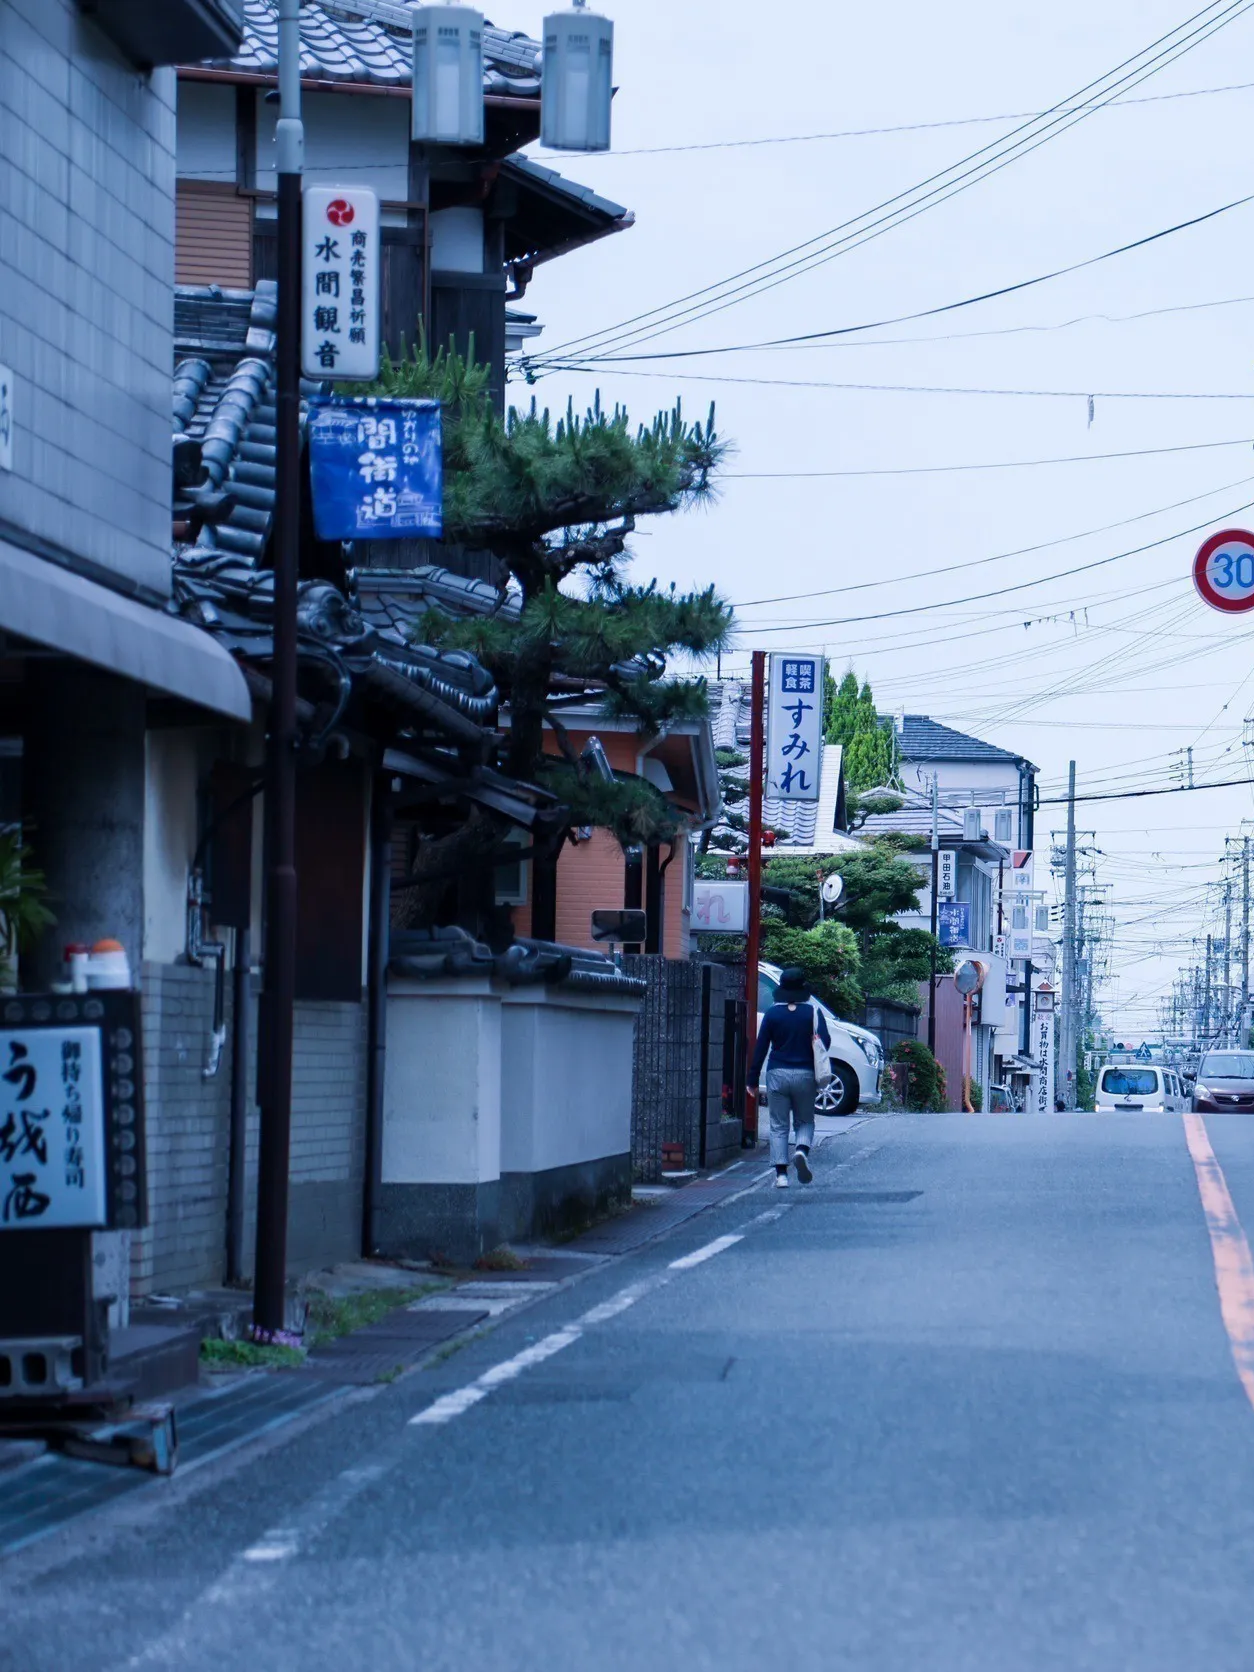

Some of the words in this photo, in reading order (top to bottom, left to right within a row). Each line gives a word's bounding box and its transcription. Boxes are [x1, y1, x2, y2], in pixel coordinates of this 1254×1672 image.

[314, 236, 341, 369] 水間観音
[355, 398, 397, 519] 間街道
[785, 663, 798, 689] 軽食
[799, 664, 812, 690] 喫茶
[781, 698, 813, 793] すみれ
[942, 853, 951, 890] 甲田石油
[61, 1040, 84, 1189] 御持ち帰り寿司
